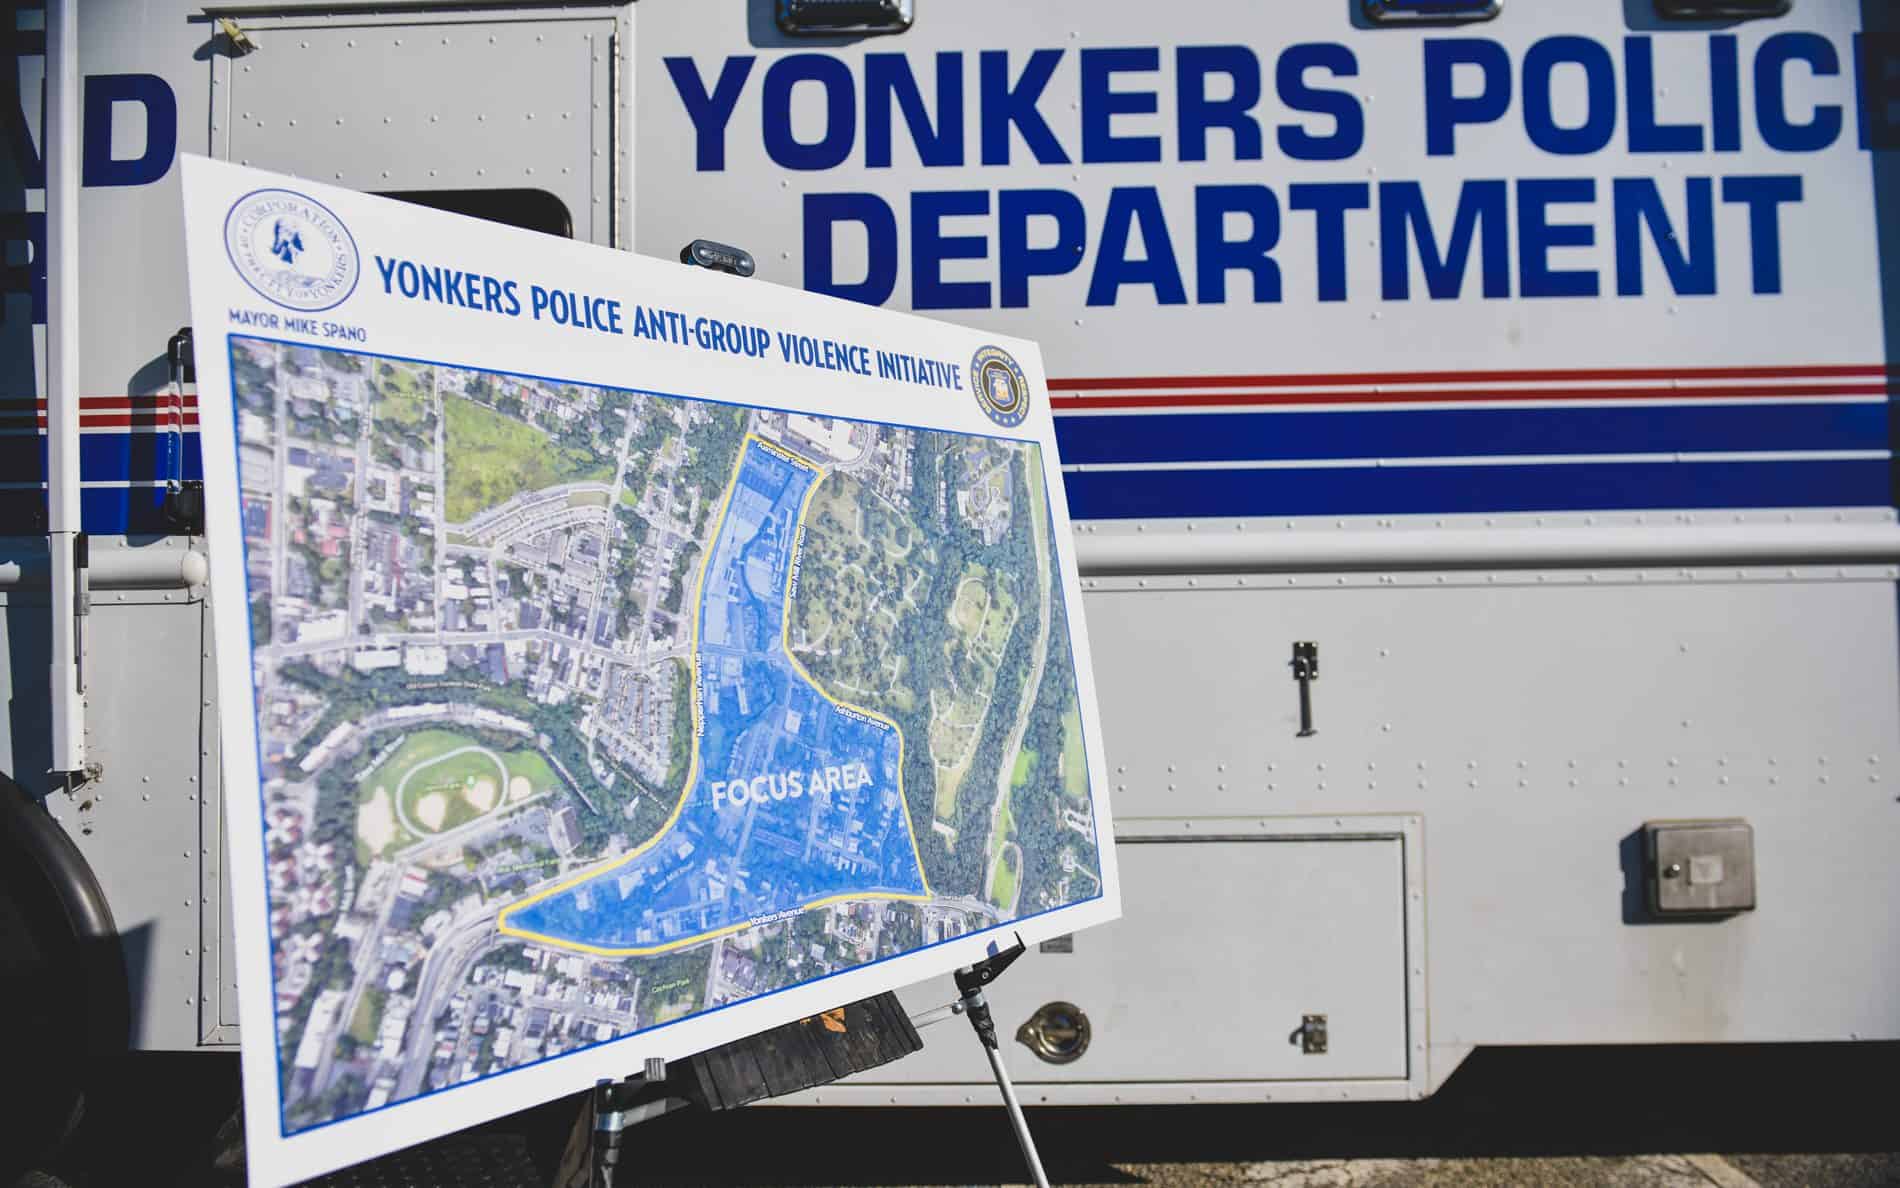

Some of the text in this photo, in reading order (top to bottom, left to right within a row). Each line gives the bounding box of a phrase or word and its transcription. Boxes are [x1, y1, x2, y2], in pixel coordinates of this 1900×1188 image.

[662, 42, 1365, 172] YONKERS
[803, 174, 1803, 310] DEPARTMENT
[228, 307, 367, 343] MAYOR MIKE SPANO
[374, 255, 964, 391] YONKERS POLICE ANTI-GROUP VIOLENCE INITIATIVE
[711, 761, 874, 811] FOCUS AREA
[778, 906, 804, 920] Avenue
